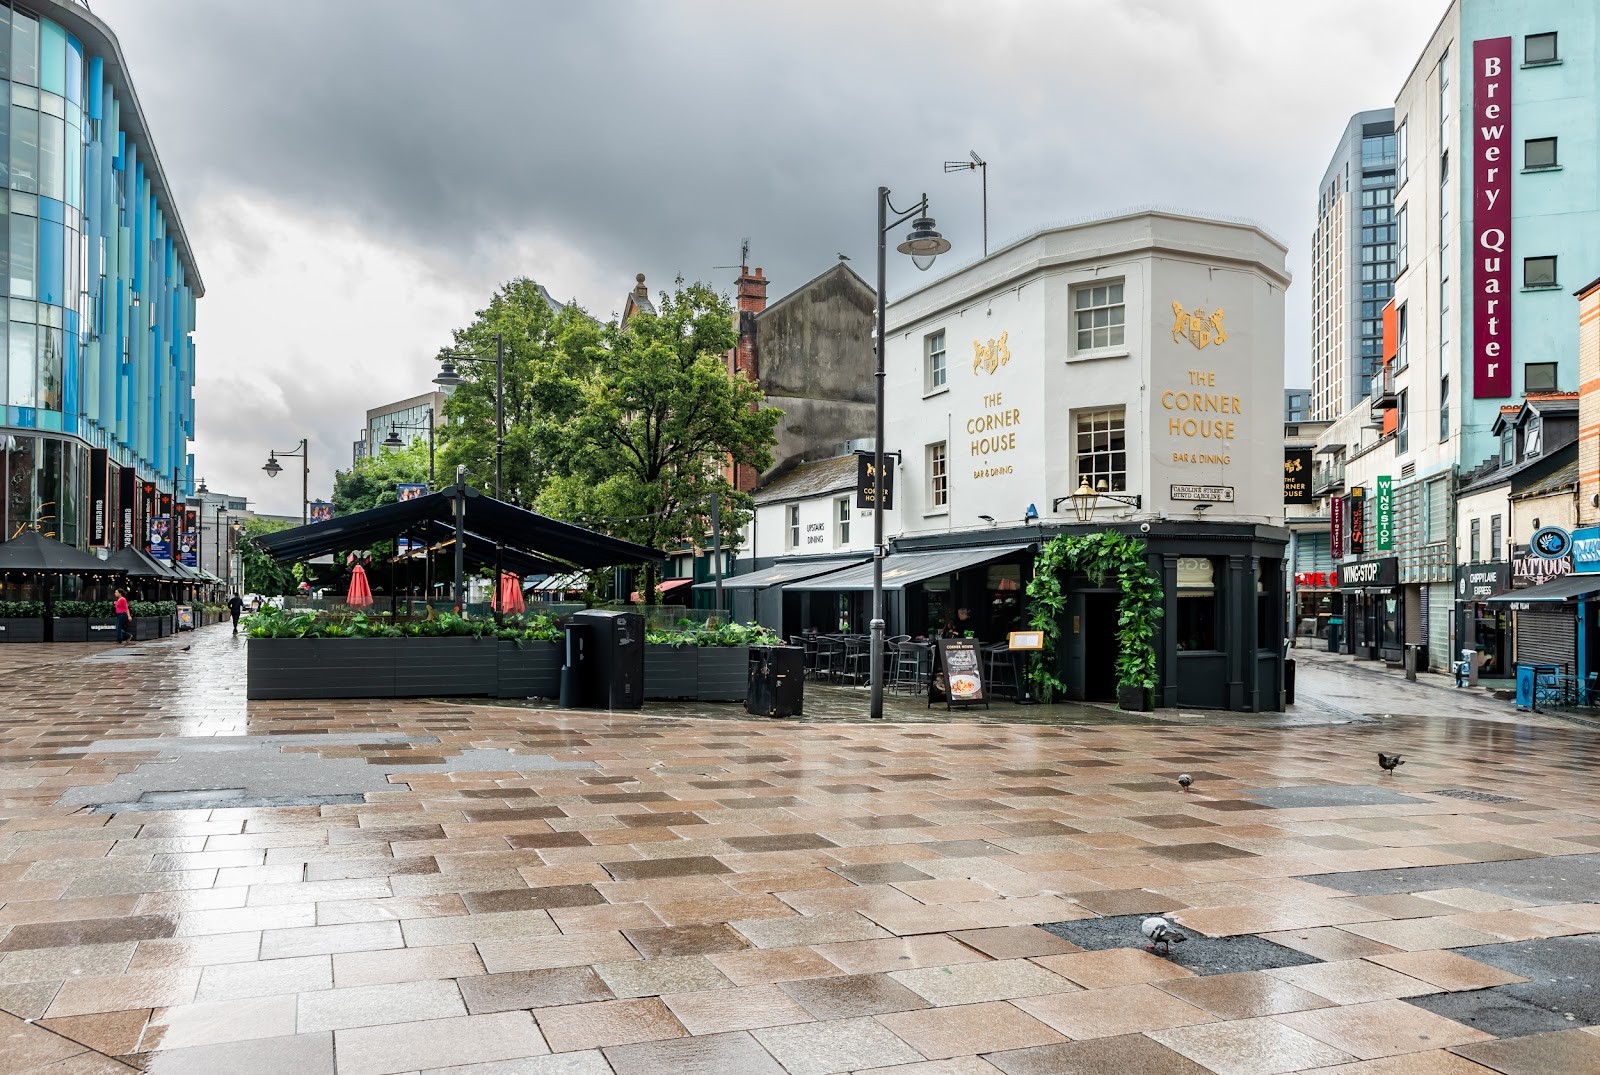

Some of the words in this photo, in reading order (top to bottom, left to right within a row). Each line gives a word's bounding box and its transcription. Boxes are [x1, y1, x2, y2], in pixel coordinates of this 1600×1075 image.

[1481, 57, 1504, 210] Brewery
[1480, 228, 1505, 378] Quarter
[1189, 370, 1215, 387] THE
[984, 392, 1002, 408] THE
[1161, 390, 1242, 415] CORNER
[966, 408, 1021, 435] CORNER
[1168, 417, 1235, 440] HOUSE
[971, 432, 1016, 457] HOUSE
[1173, 452, 1189, 463] BAR
[1191, 454, 1197, 464] &
[1199, 454, 1231, 465] DINING
[973, 470, 984, 479] BAR
[985, 469, 990, 478] &
[990, 465, 1014, 477] DINING
[95, 499, 104, 540] wagamama
[807, 522, 824, 532] UPSTAIRS
[807, 535, 823, 544] DINING
[1513, 556, 1571, 577] TATTOOS
